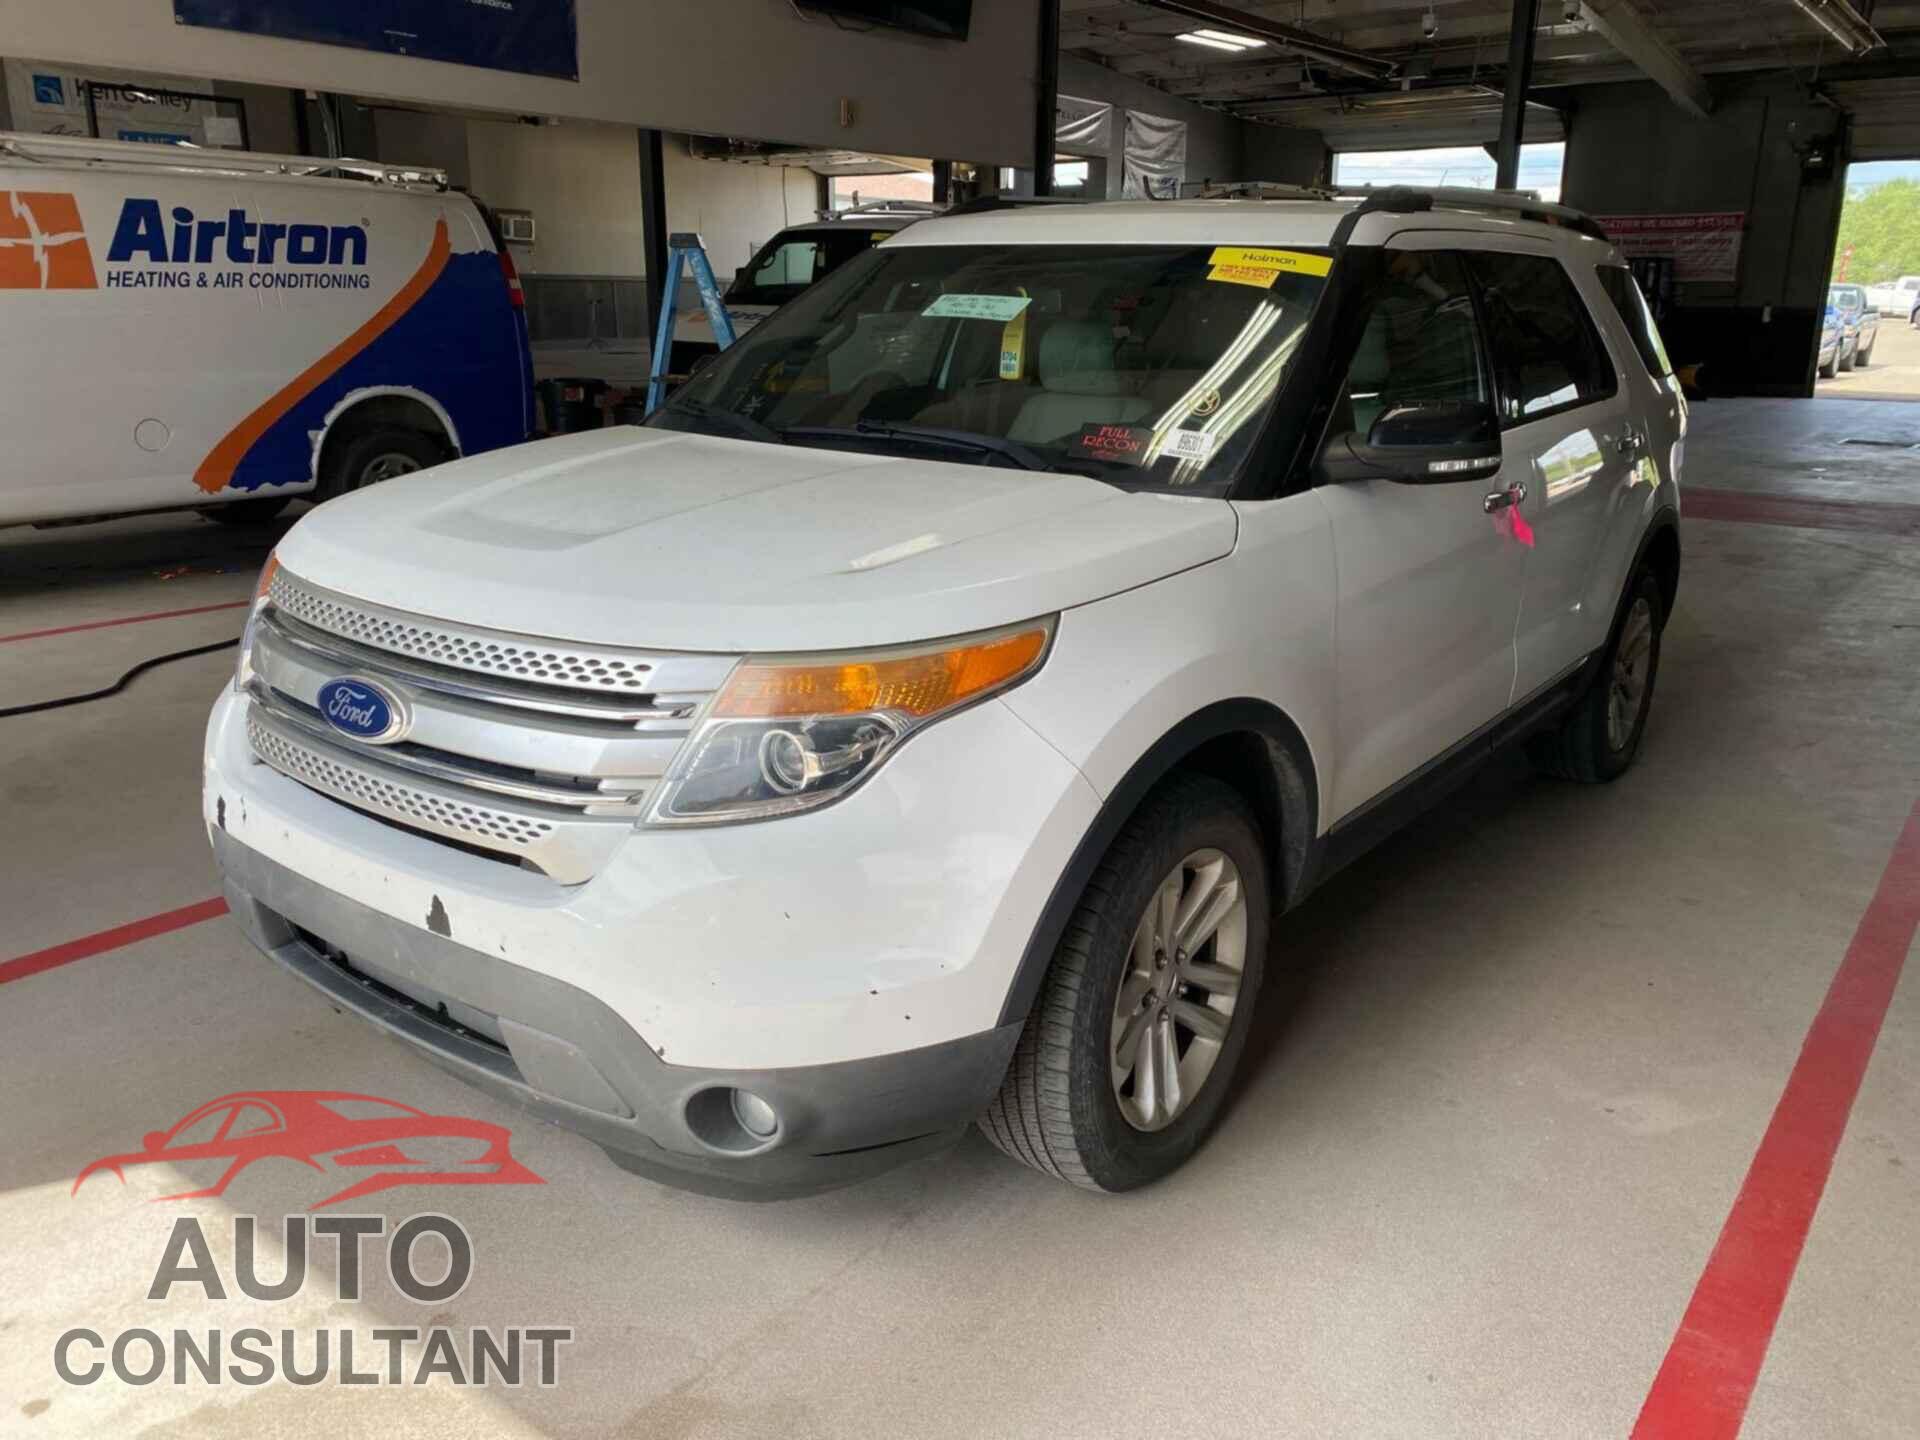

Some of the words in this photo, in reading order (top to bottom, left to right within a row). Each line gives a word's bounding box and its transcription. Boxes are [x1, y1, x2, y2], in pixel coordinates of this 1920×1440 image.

[106, 197, 368, 265] Airtron
[1241, 252, 1298, 267] Holman
[106, 270, 191, 289] HEATING
[196, 271, 209, 289] &
[213, 272, 245, 289] AIR
[248, 272, 370, 290] CONDITIONING
[1099, 425, 1131, 439] FULL
[1081, 435, 1141, 452] RECON
[328, 686, 377, 728] Ford
